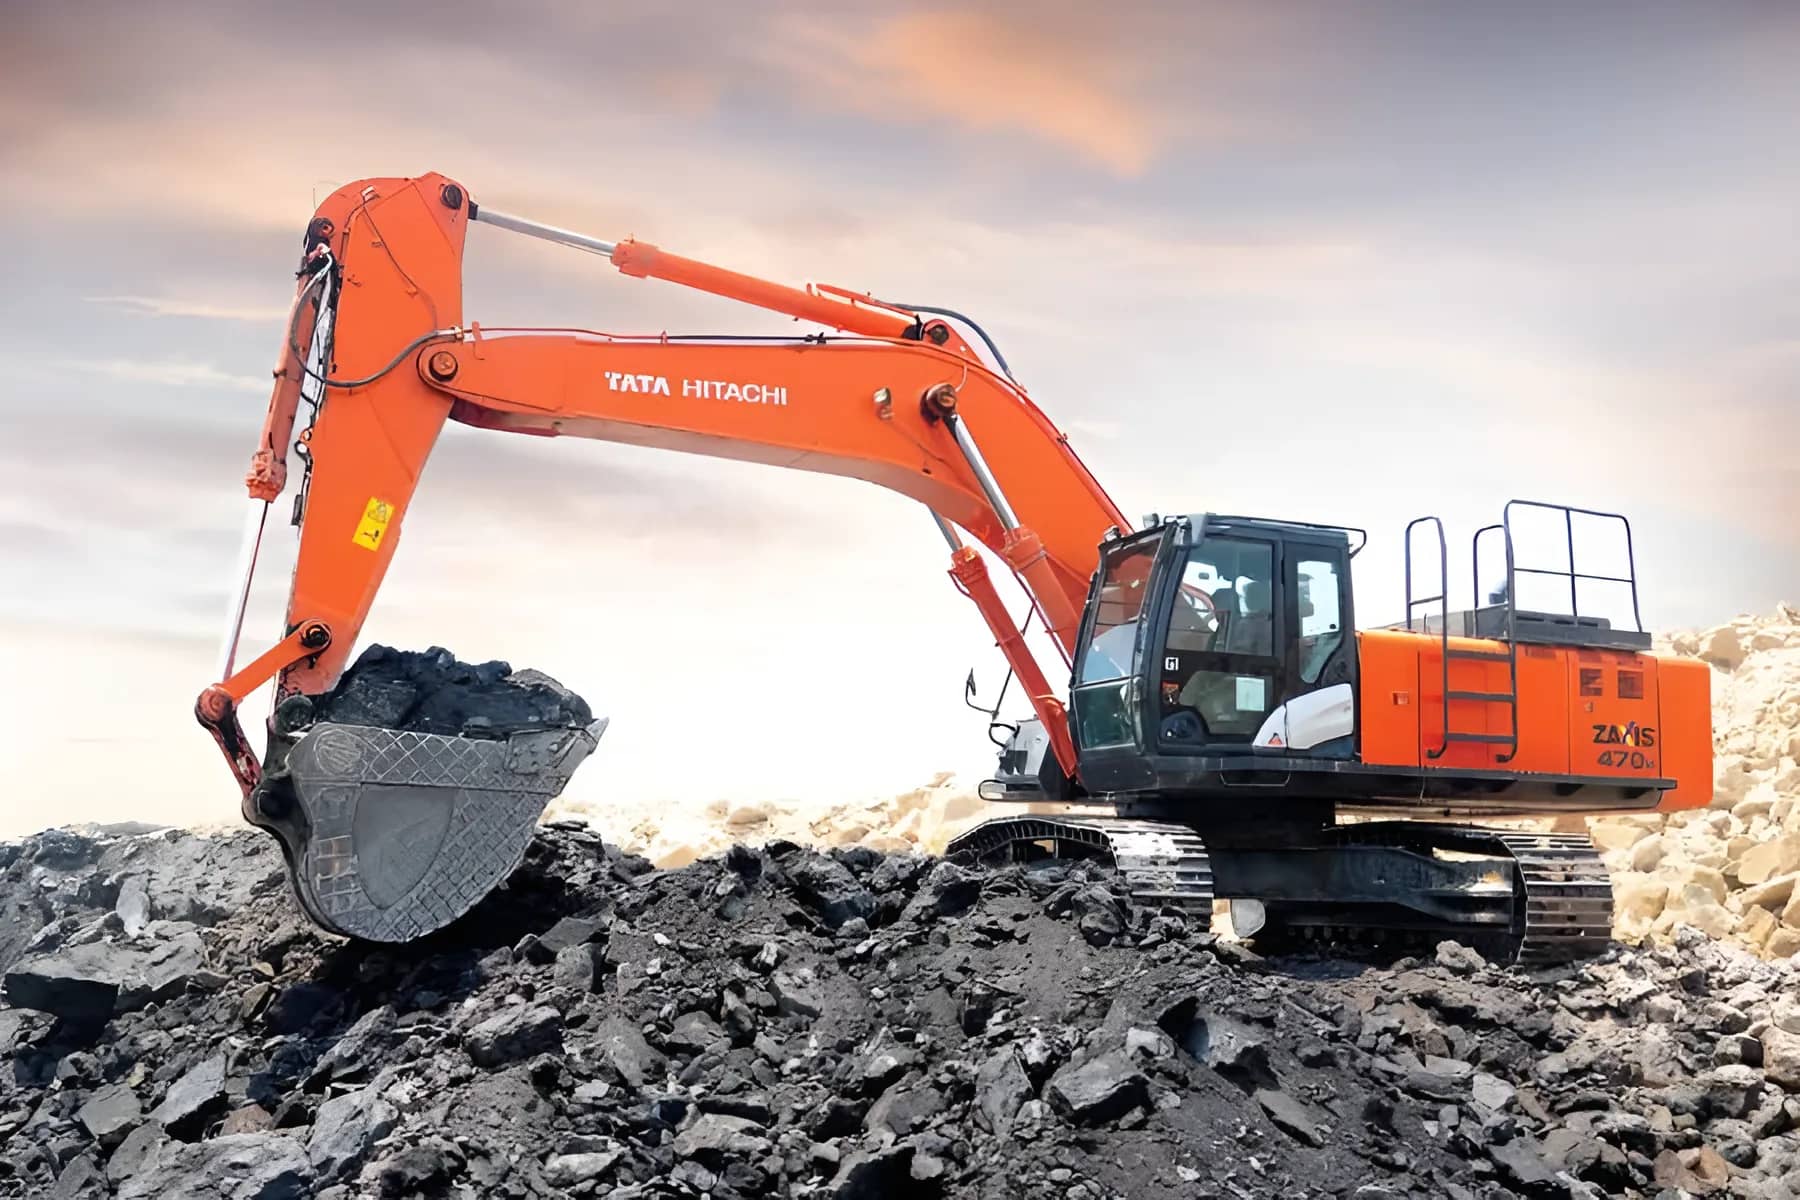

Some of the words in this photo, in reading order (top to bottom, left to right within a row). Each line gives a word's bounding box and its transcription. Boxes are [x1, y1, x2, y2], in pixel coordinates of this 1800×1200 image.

[604, 371, 670, 396] TATA
[682, 379, 787, 405] HITACHI
[1592, 720, 1655, 747] ZAXIS
